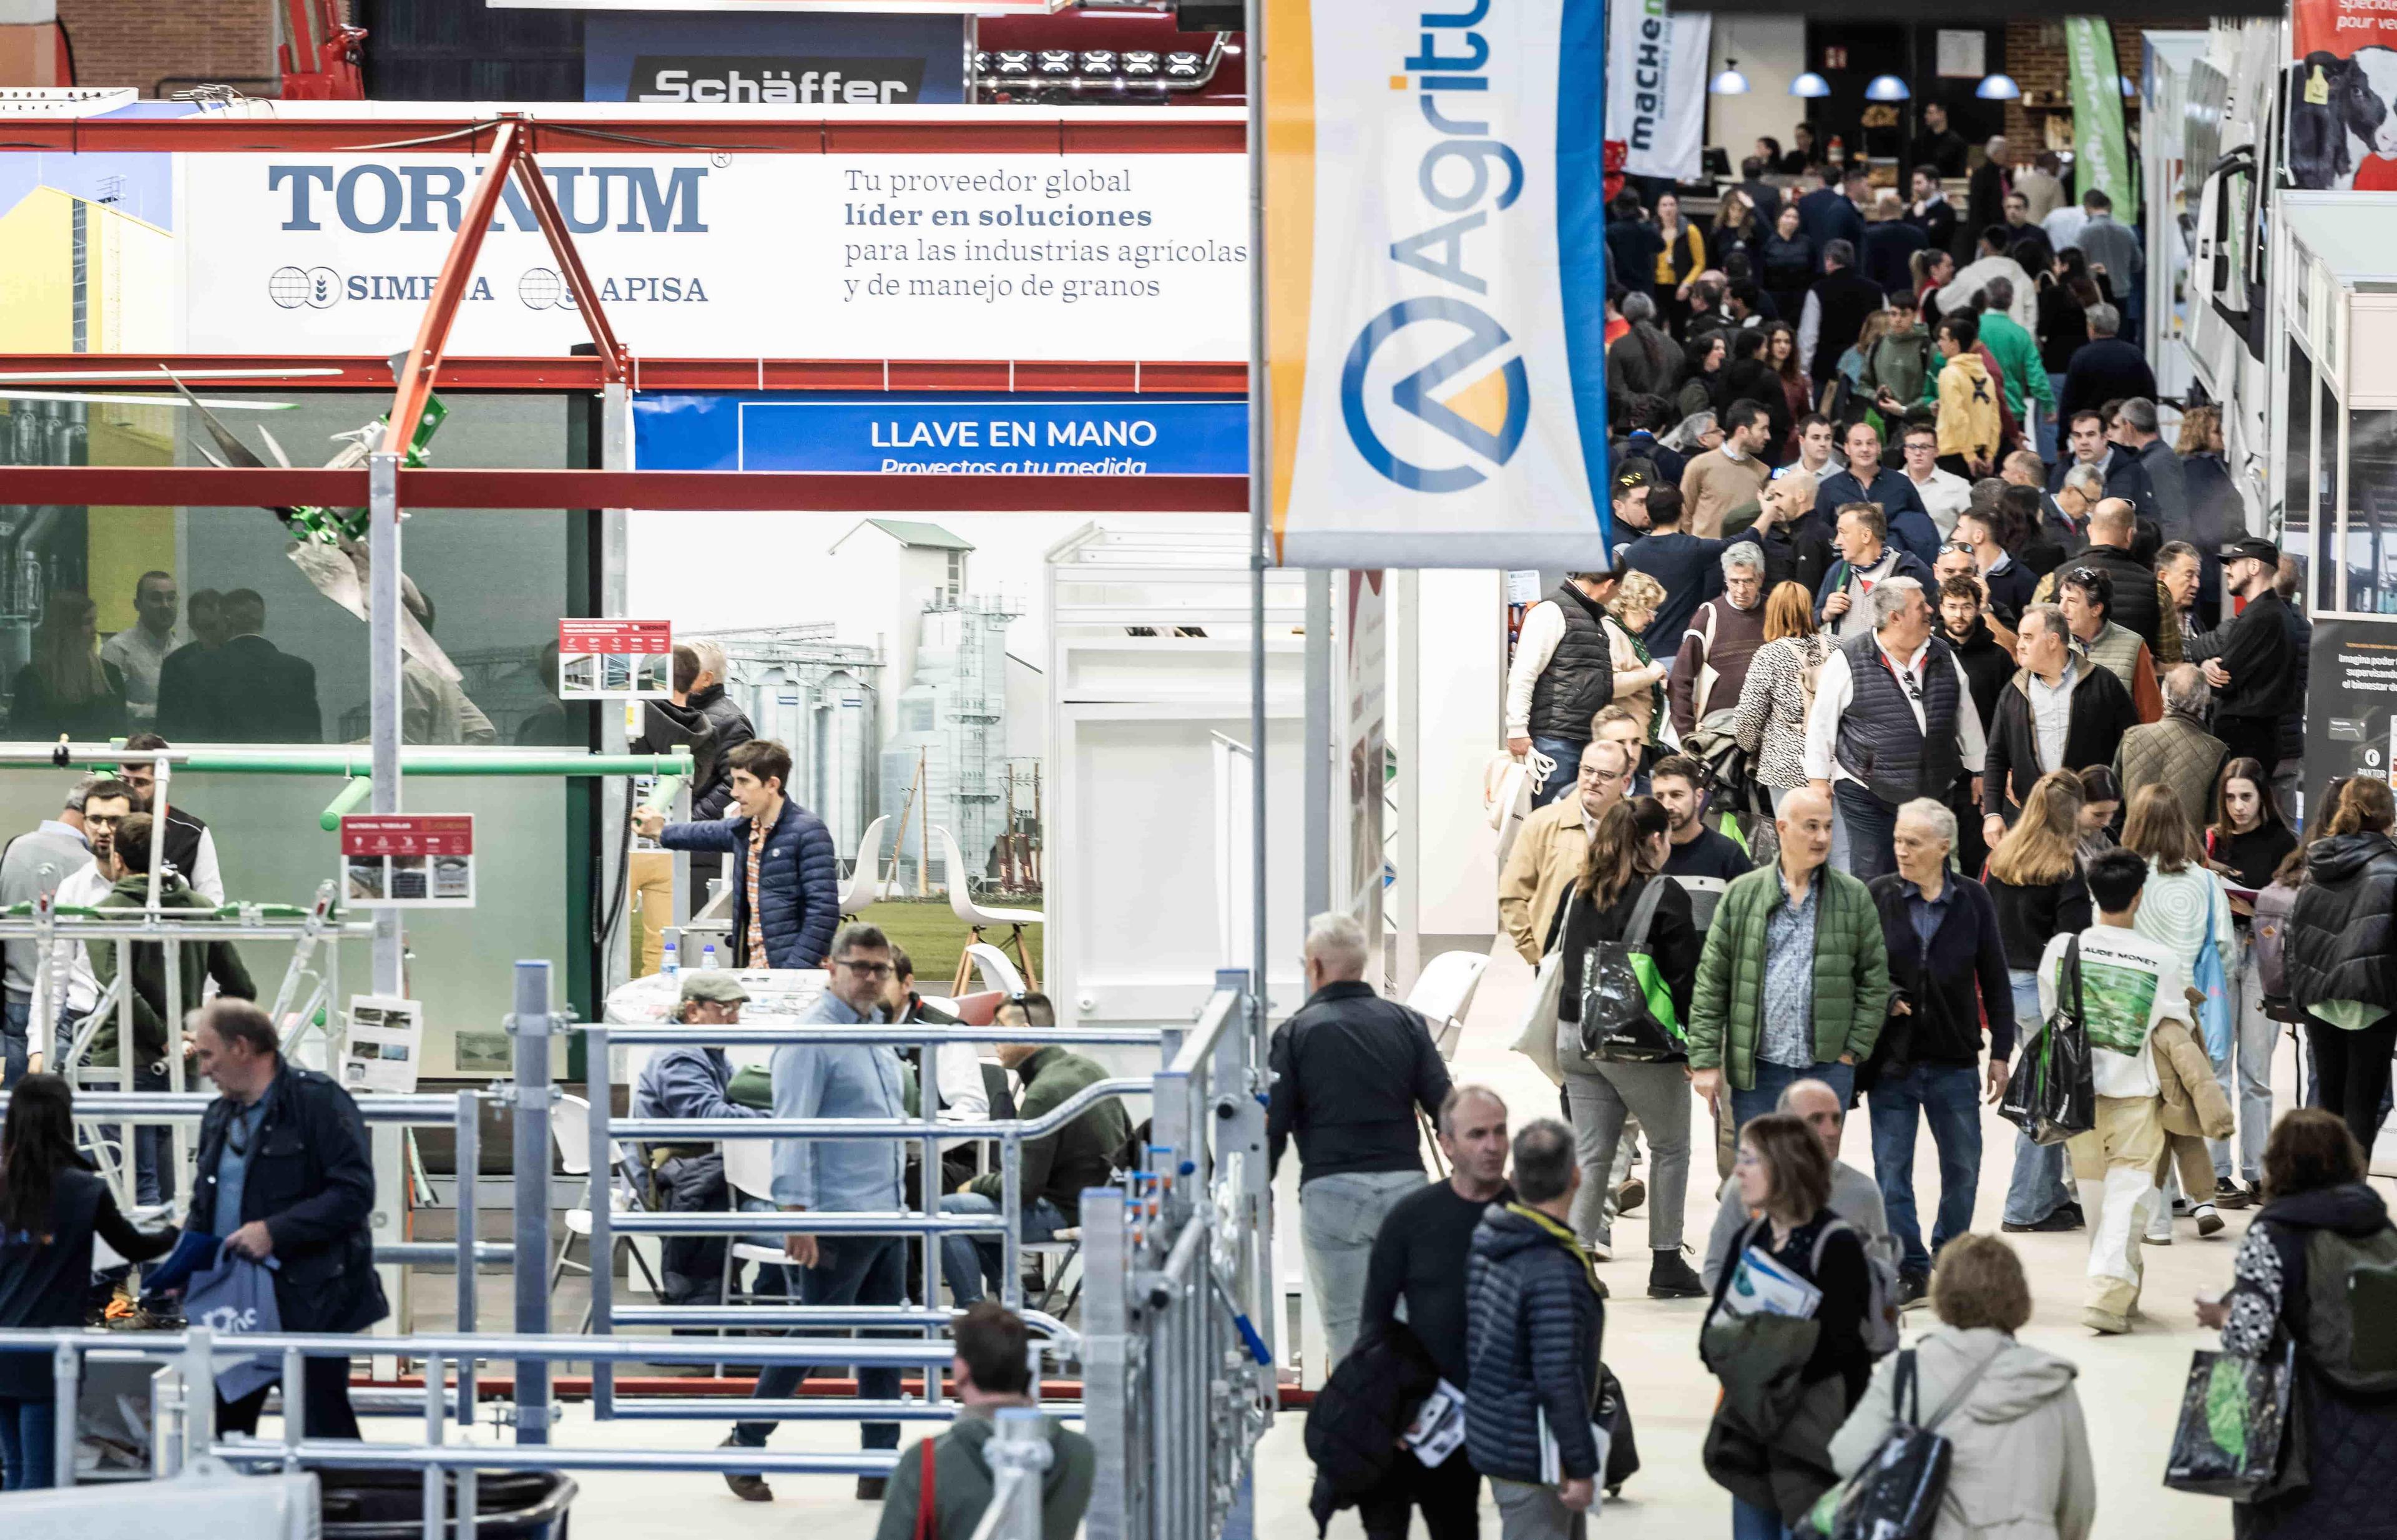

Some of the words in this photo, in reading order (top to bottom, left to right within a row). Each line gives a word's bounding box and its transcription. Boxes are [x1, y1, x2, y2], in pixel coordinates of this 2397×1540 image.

[2335, 16, 2375, 31] pour
[639, 70, 908, 104] Schäffer
[845, 170, 881, 191] Tu
[890, 169, 1036, 198] proveedor
[1046, 169, 1131, 198] global
[845, 204, 923, 226] líder
[933, 210, 970, 226] en
[979, 204, 1152, 227] soluciones
[845, 245, 909, 267] para
[918, 239, 956, 261] las
[965, 238, 1109, 262] industrias
[1119, 240, 1247, 268] agrícolas
[347, 275, 494, 301] SIMEA
[845, 280, 860, 303] y
[869, 273, 899, 295] de
[909, 274, 1011, 303] manejo
[1022, 273, 1053, 296] de
[1063, 280, 1160, 303] granos
[871, 421, 980, 448] LLAVE
[989, 421, 1036, 448] EN
[1047, 420, 1158, 448] MANO
[1002, 461, 1019, 474] a
[1024, 459, 1049, 474] tu
[1057, 458, 1147, 475] medida
[2117, 953, 2159, 968] MONET
